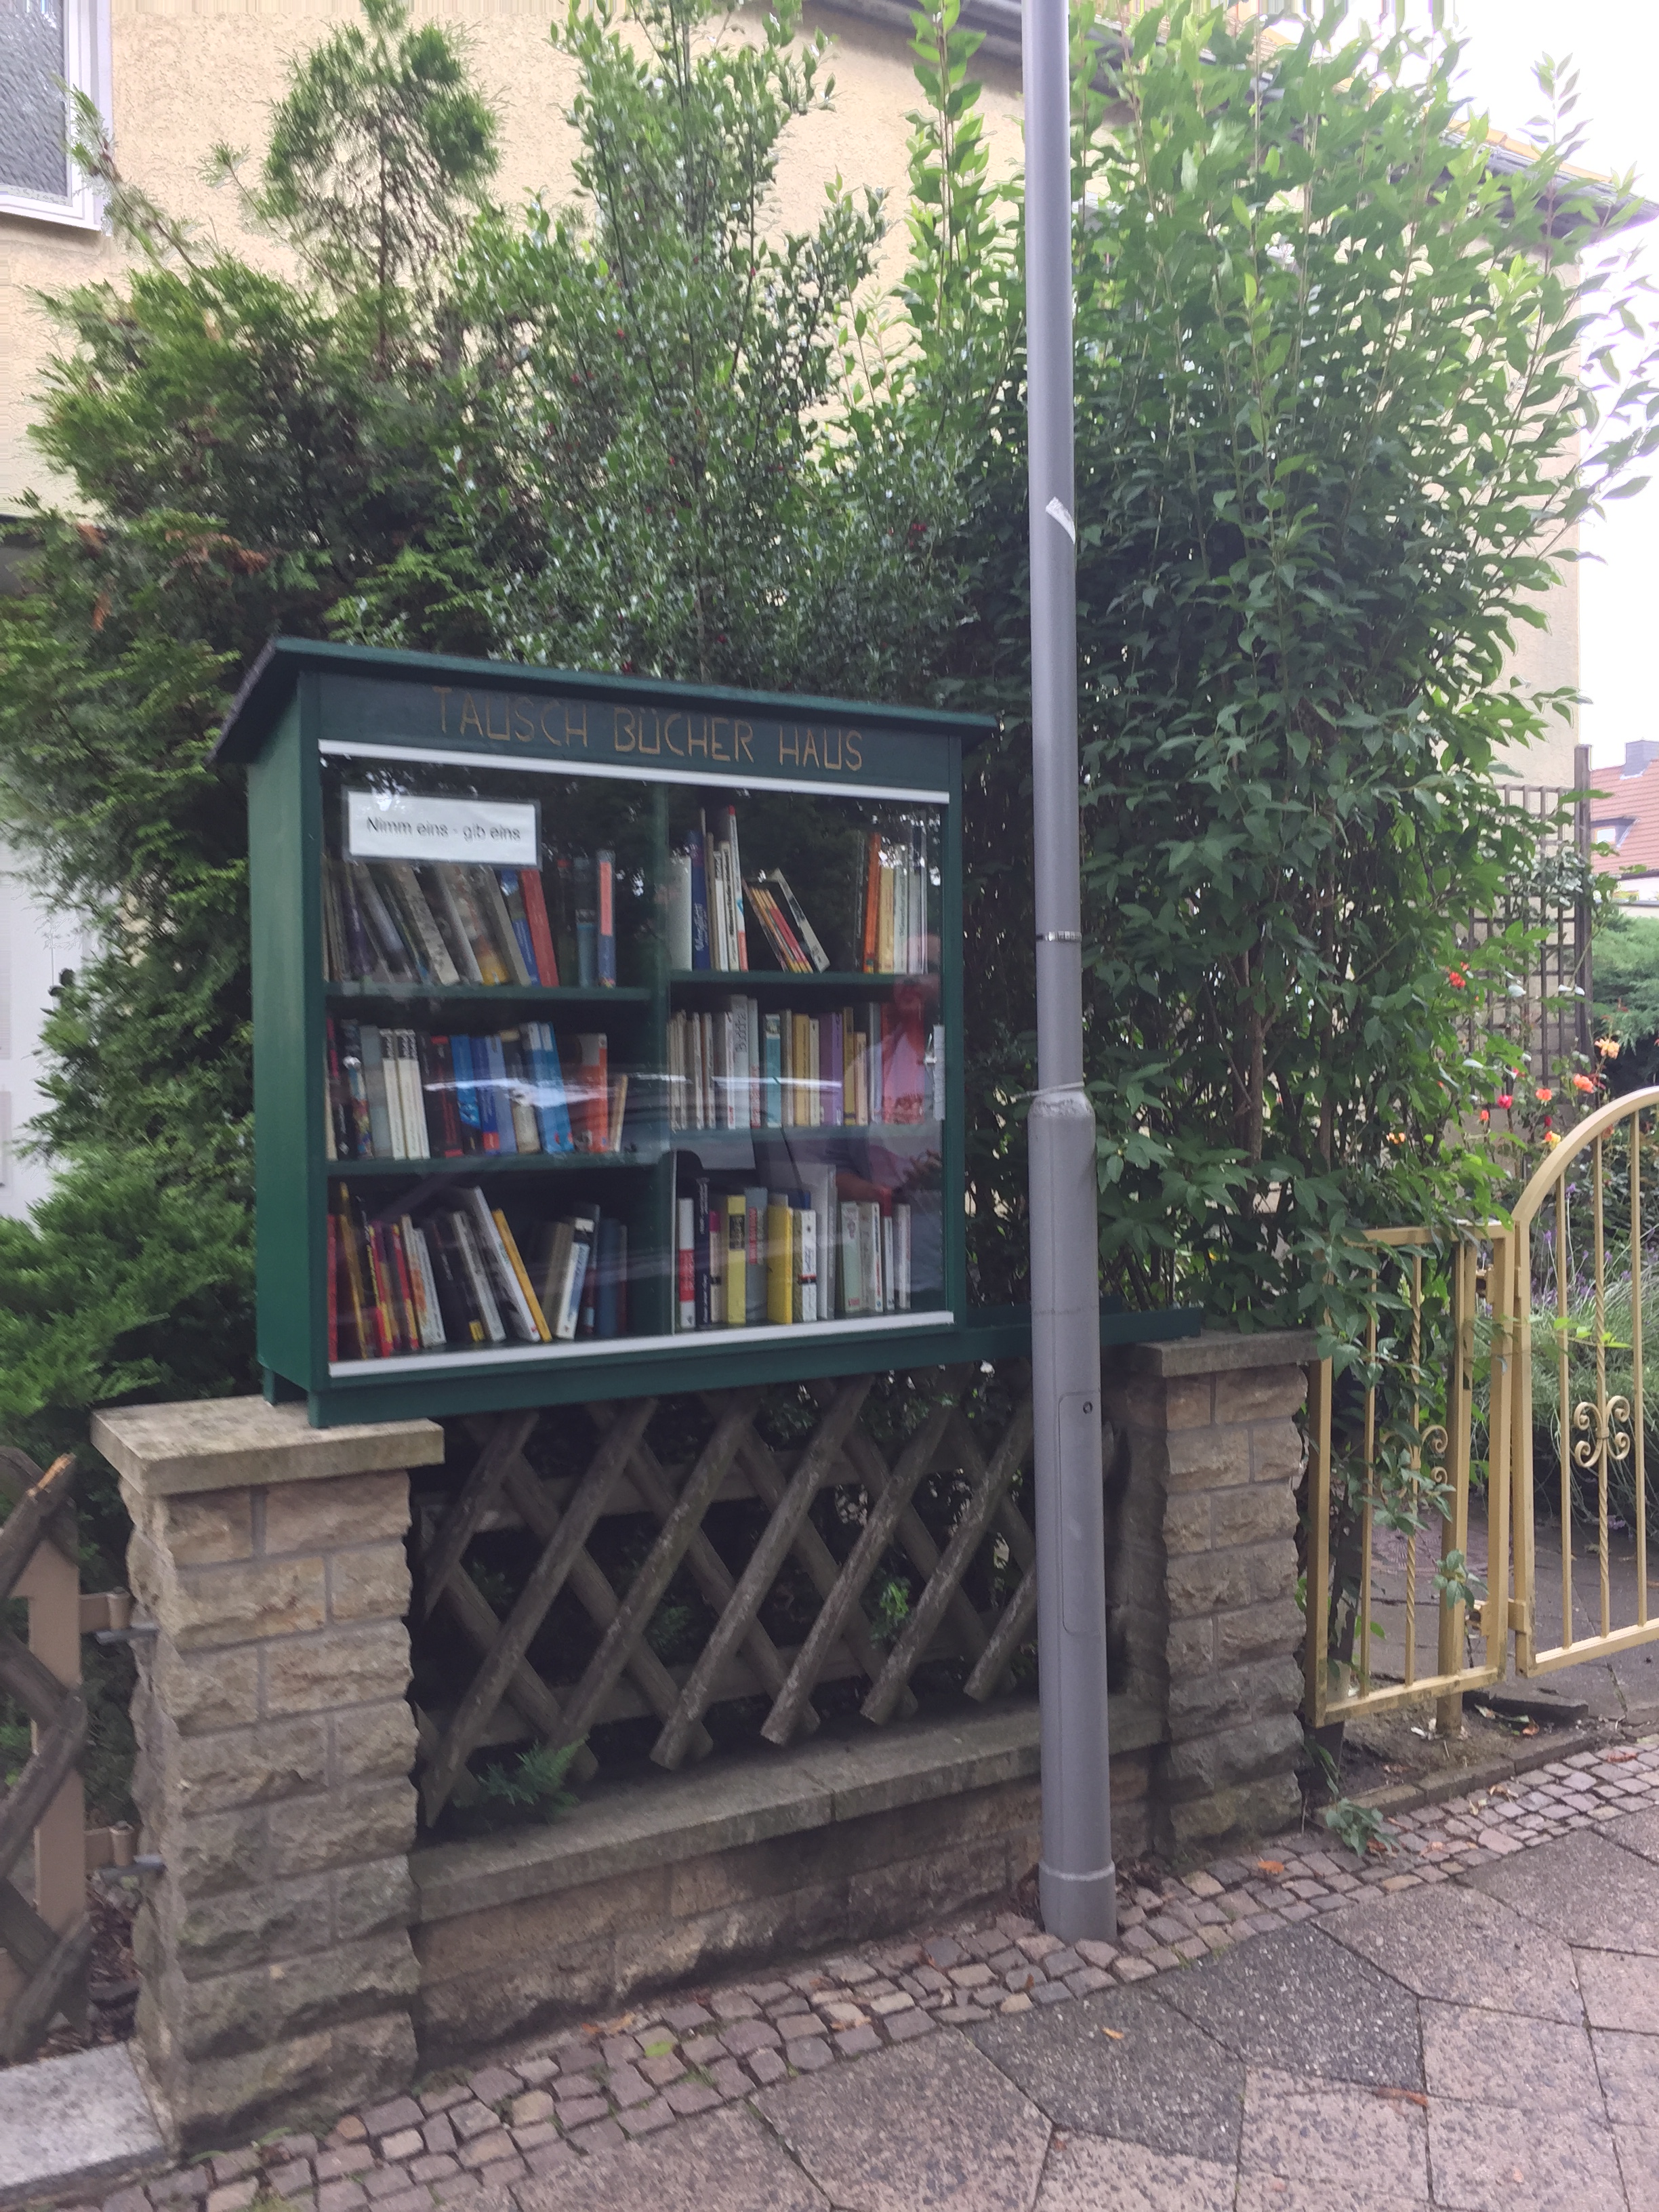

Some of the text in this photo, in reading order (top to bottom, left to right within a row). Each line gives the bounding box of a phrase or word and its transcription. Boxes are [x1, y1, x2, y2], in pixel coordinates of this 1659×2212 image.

[432, 685, 863, 772] TAUSCH BÜCHER HAUS
[367, 816, 412, 834] Nimm
[417, 821, 449, 838] eins
[462, 823, 485, 843] gib
[489, 824, 520, 841] eins
